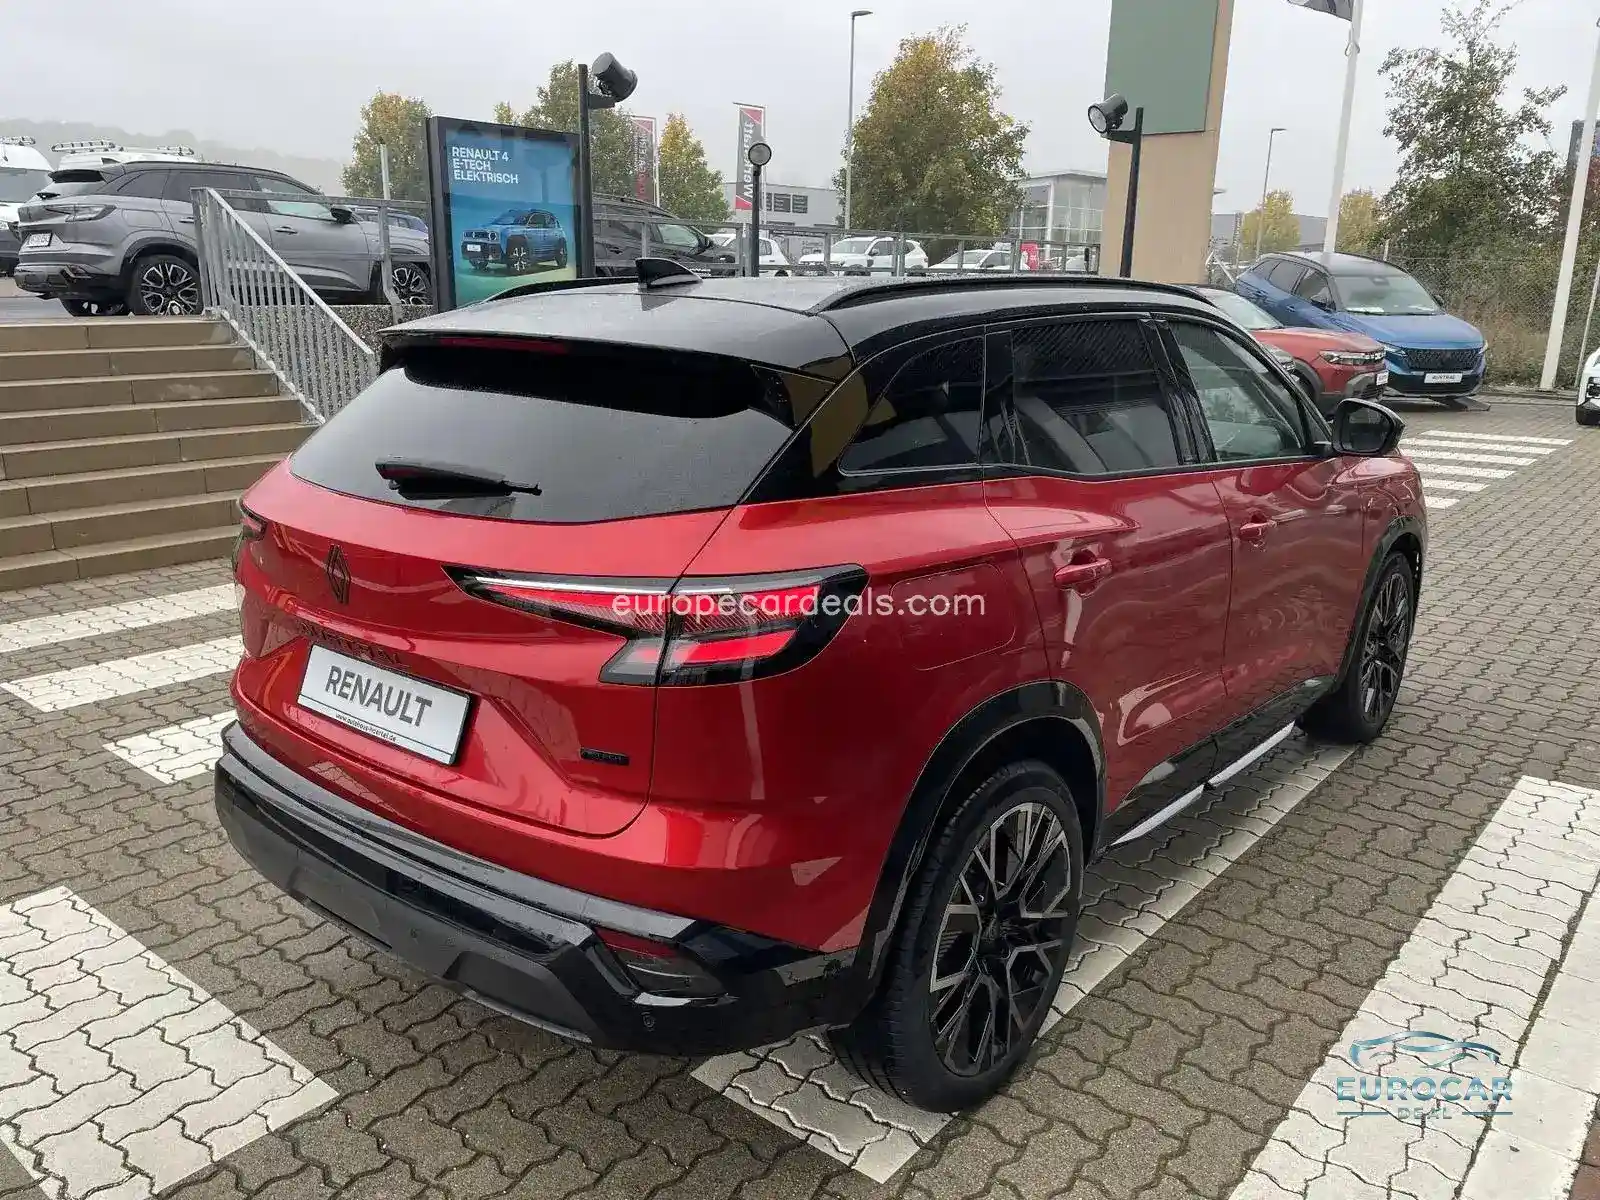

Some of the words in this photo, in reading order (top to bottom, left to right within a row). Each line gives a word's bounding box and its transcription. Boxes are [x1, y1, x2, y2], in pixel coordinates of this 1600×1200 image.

[451, 146, 501, 161] RENAULT
[501, 151, 510, 162] 4
[452, 158, 491, 171] E-TECH
[453, 169, 519, 184] ELEKTRISCH
[324, 664, 433, 729] RENAULT
